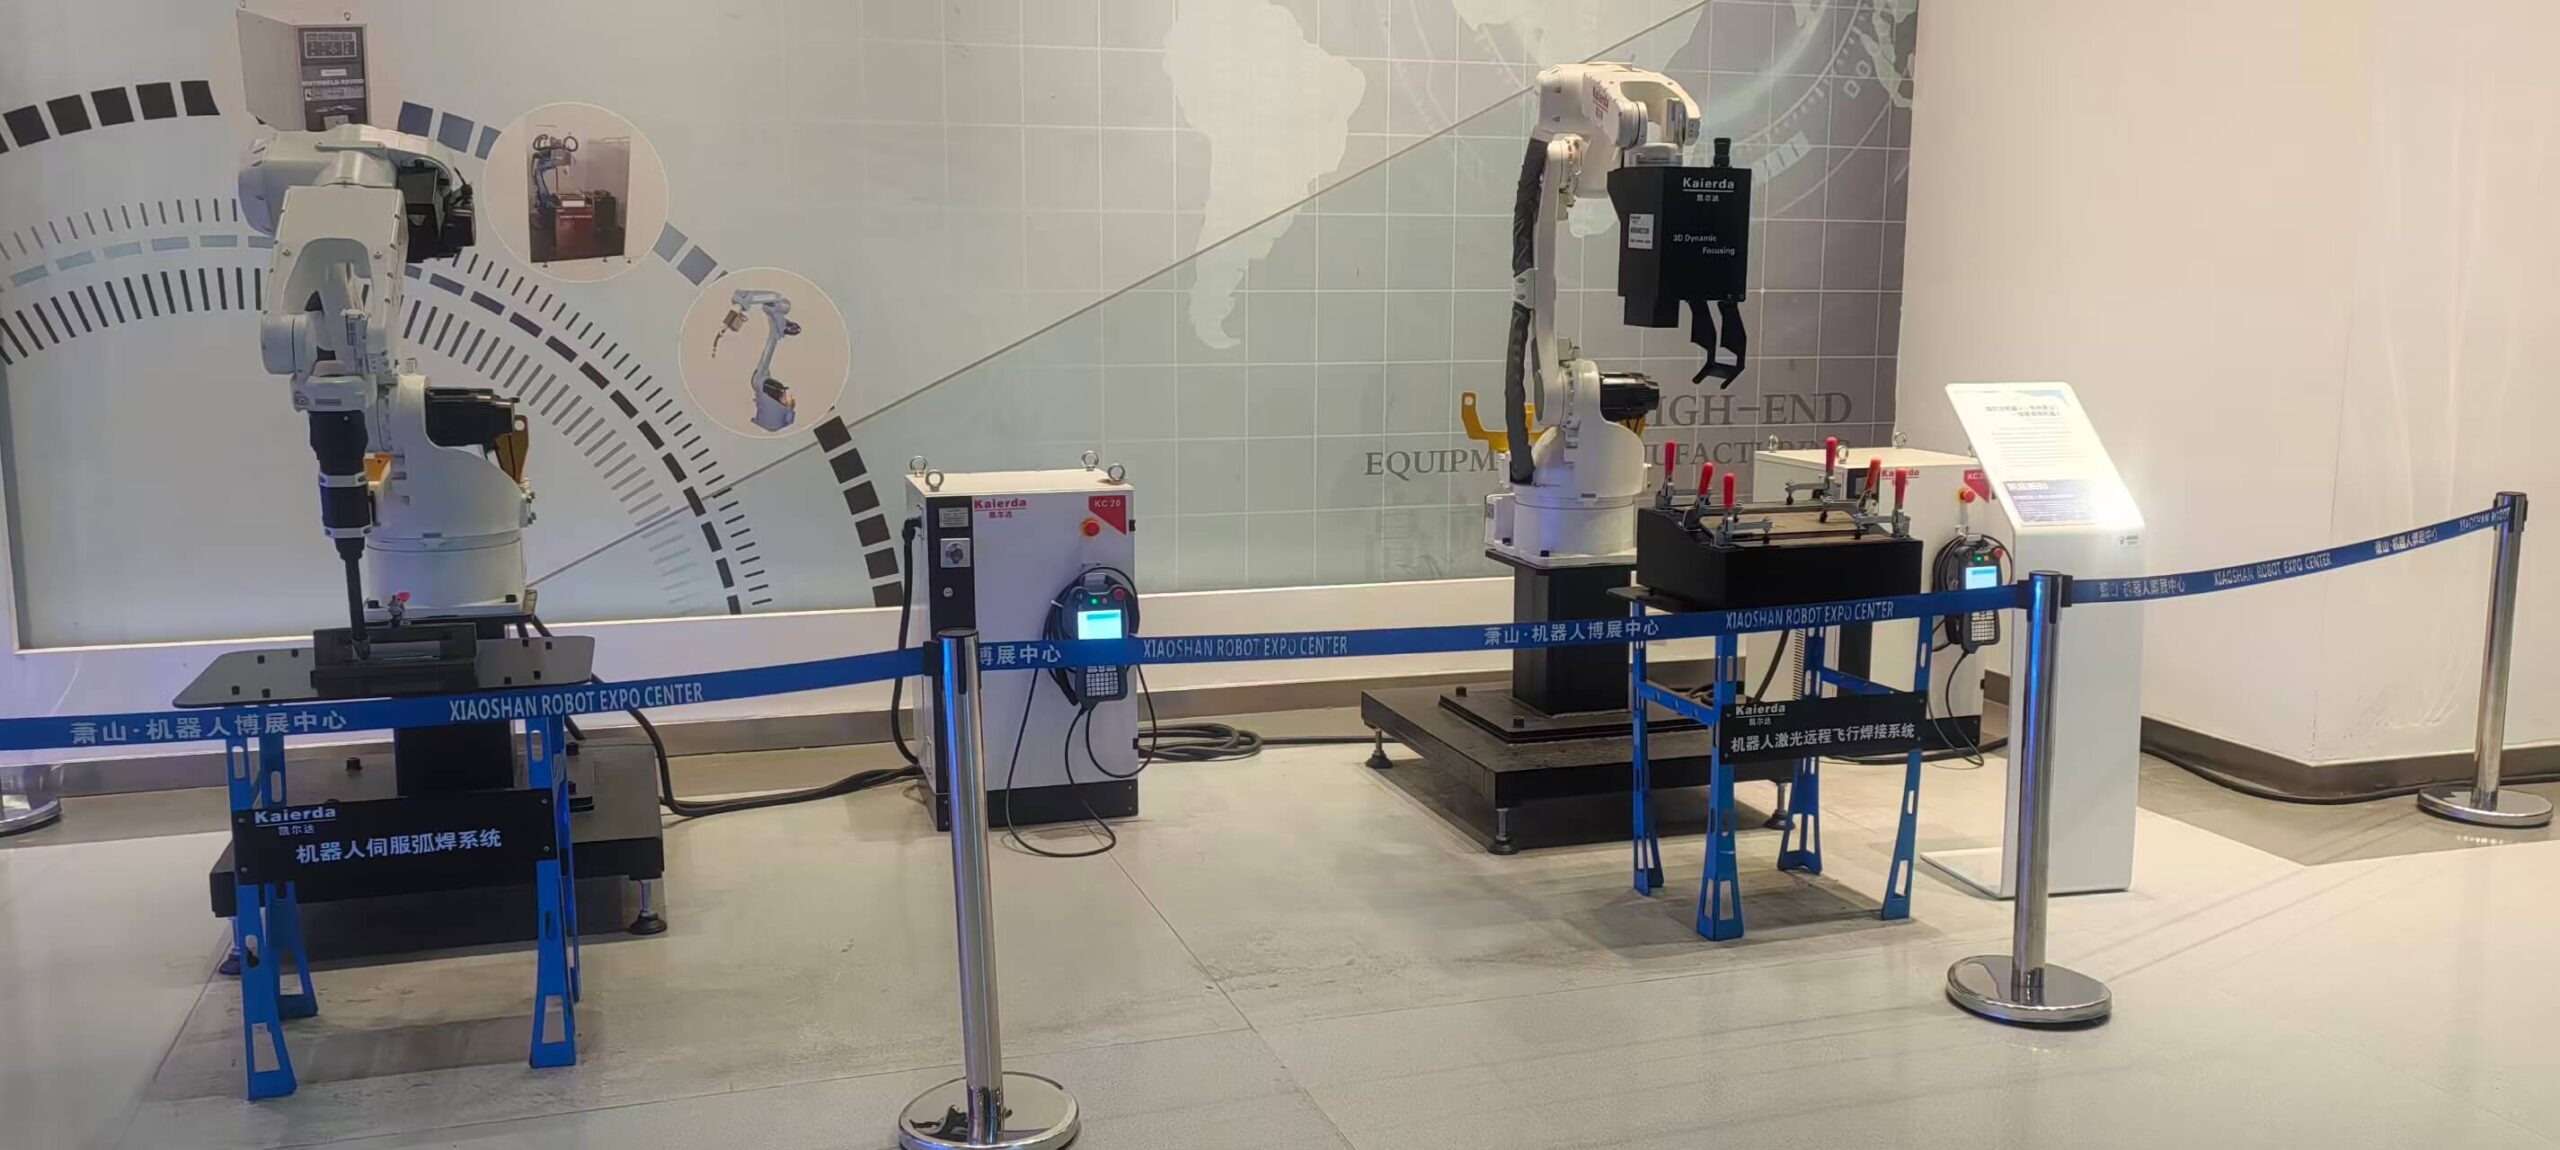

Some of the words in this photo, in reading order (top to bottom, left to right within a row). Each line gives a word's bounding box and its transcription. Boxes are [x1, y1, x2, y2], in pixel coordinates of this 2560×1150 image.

[1683, 177, 1735, 189] Kaierda
[1673, 234, 1683, 242] 3D
[1685, 234, 1717, 243] Dynamic
[1702, 247, 1736, 256] Focusing
[1647, 392, 1852, 426] IGH-END
[1364, 449, 1499, 481] EQUIPM
[974, 498, 1026, 508] Kaierda
[1094, 500, 1107, 508] KC
[2214, 568, 2254, 586] XIAOSHAN
[2257, 562, 2281, 579] ROBOT
[2283, 558, 2303, 574] EXPO
[2305, 553, 2332, 570] CENTER
[1726, 609, 1783, 629] XIAOSHAN
[1785, 607, 1822, 626] ROBOT
[1824, 605, 1852, 622] EXPO
[1854, 601, 1894, 619] CENTER
[1143, 640, 1213, 659] XIAOSHAN
[1217, 639, 1262, 657] ROBOT
[1264, 638, 1297, 656] EXPO
[1300, 636, 1348, 655] CENTER
[450, 695, 537, 721] XIAOSHAN
[542, 691, 595, 716] ROBOT
[601, 687, 640, 710] EXPO
[644, 682, 703, 707] CENTER
[1736, 703, 1786, 716] Kaierda
[1730, 722, 1915, 753] 机器人激光远程飞行焊接系统
[255, 806, 336, 824] Kaierda
[278, 824, 316, 836] 凯尔达
[296, 828, 502, 864] 机器人伺服弧焊系统
